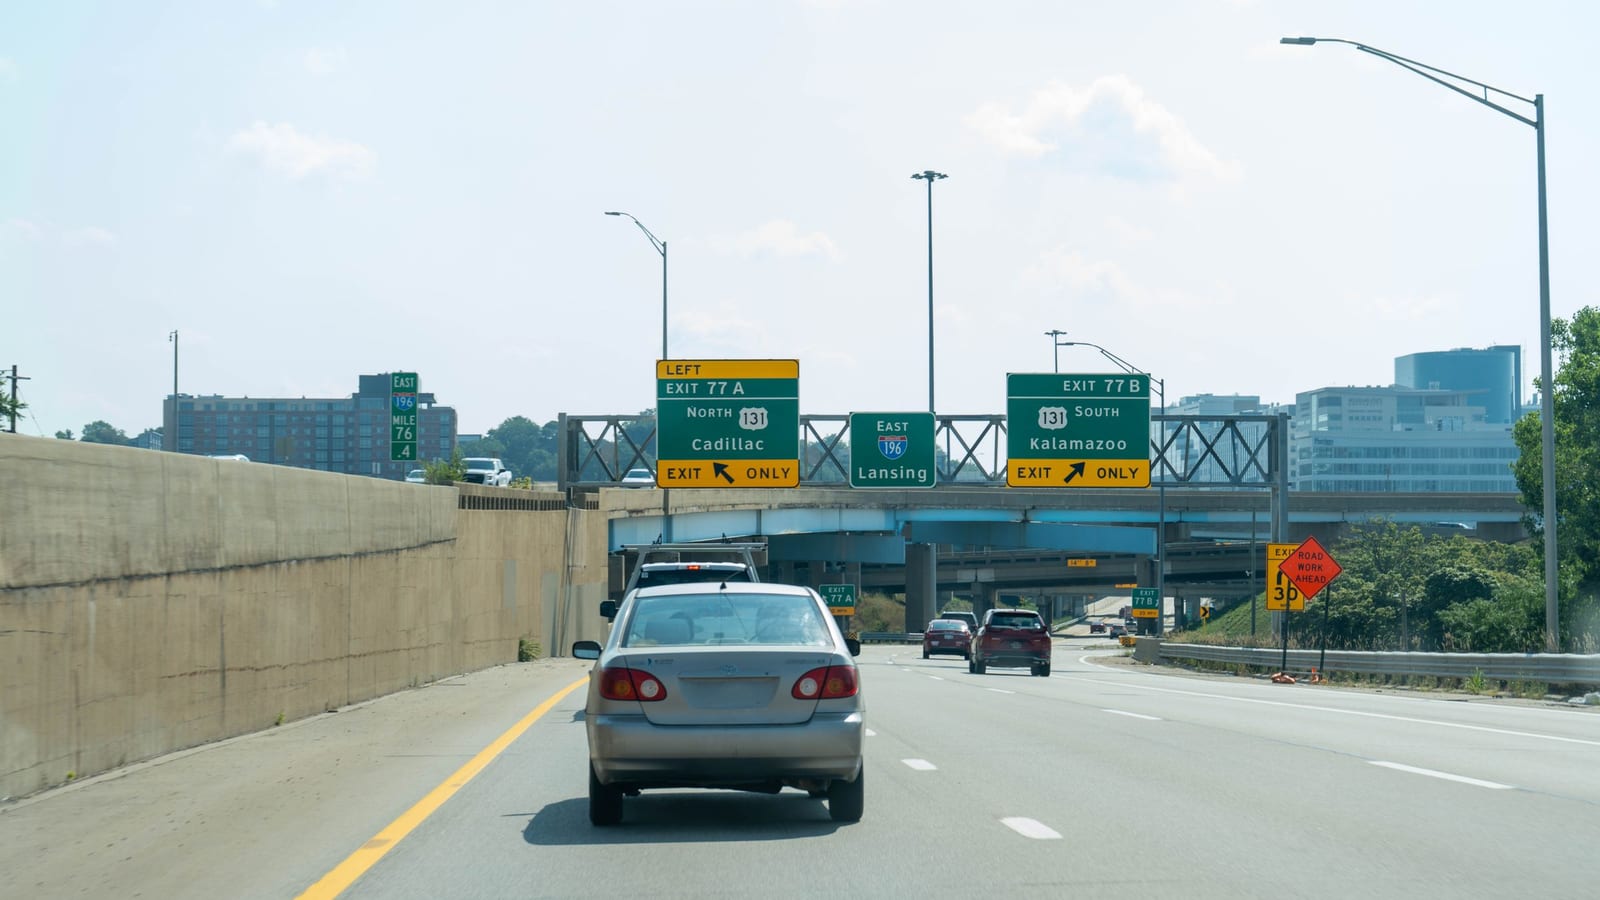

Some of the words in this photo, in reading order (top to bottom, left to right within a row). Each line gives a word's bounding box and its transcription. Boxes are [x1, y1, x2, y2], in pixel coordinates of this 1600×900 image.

[666, 364, 702, 375] LEFT
[394, 376, 414, 388] EAST
[666, 383, 699, 394] EXIT
[707, 381, 727, 395] 77
[732, 381, 745, 395] A
[1063, 380, 1096, 391] EXIT
[1104, 379, 1124, 392] 77
[1129, 379, 1140, 393] B
[396, 396, 413, 407] 196
[392, 415, 416, 426] MILE
[743, 412, 765, 425] 131
[1043, 411, 1064, 425] 131
[876, 420, 909, 432] EAST
[395, 426, 413, 440] 76
[691, 437, 765, 451] Cadillac
[884, 441, 902, 455] 196
[1030, 437, 1127, 450] Kalamazoo
[397, 444, 411, 458] .4
[667, 467, 702, 480] EXIT
[746, 467, 790, 479] ONLY
[858, 465, 927, 483] Lansing
[1017, 467, 1052, 479] EXIT
[1096, 467, 1139, 479] ONLY
[1298, 552, 1323, 560] ROAD
[1298, 563, 1323, 571] WORK
[1296, 575, 1326, 583] AHEAD
[831, 594, 843, 602] 77
[845, 594, 852, 602] A
[1134, 597, 1144, 605] 77
[1146, 597, 1153, 605] B
